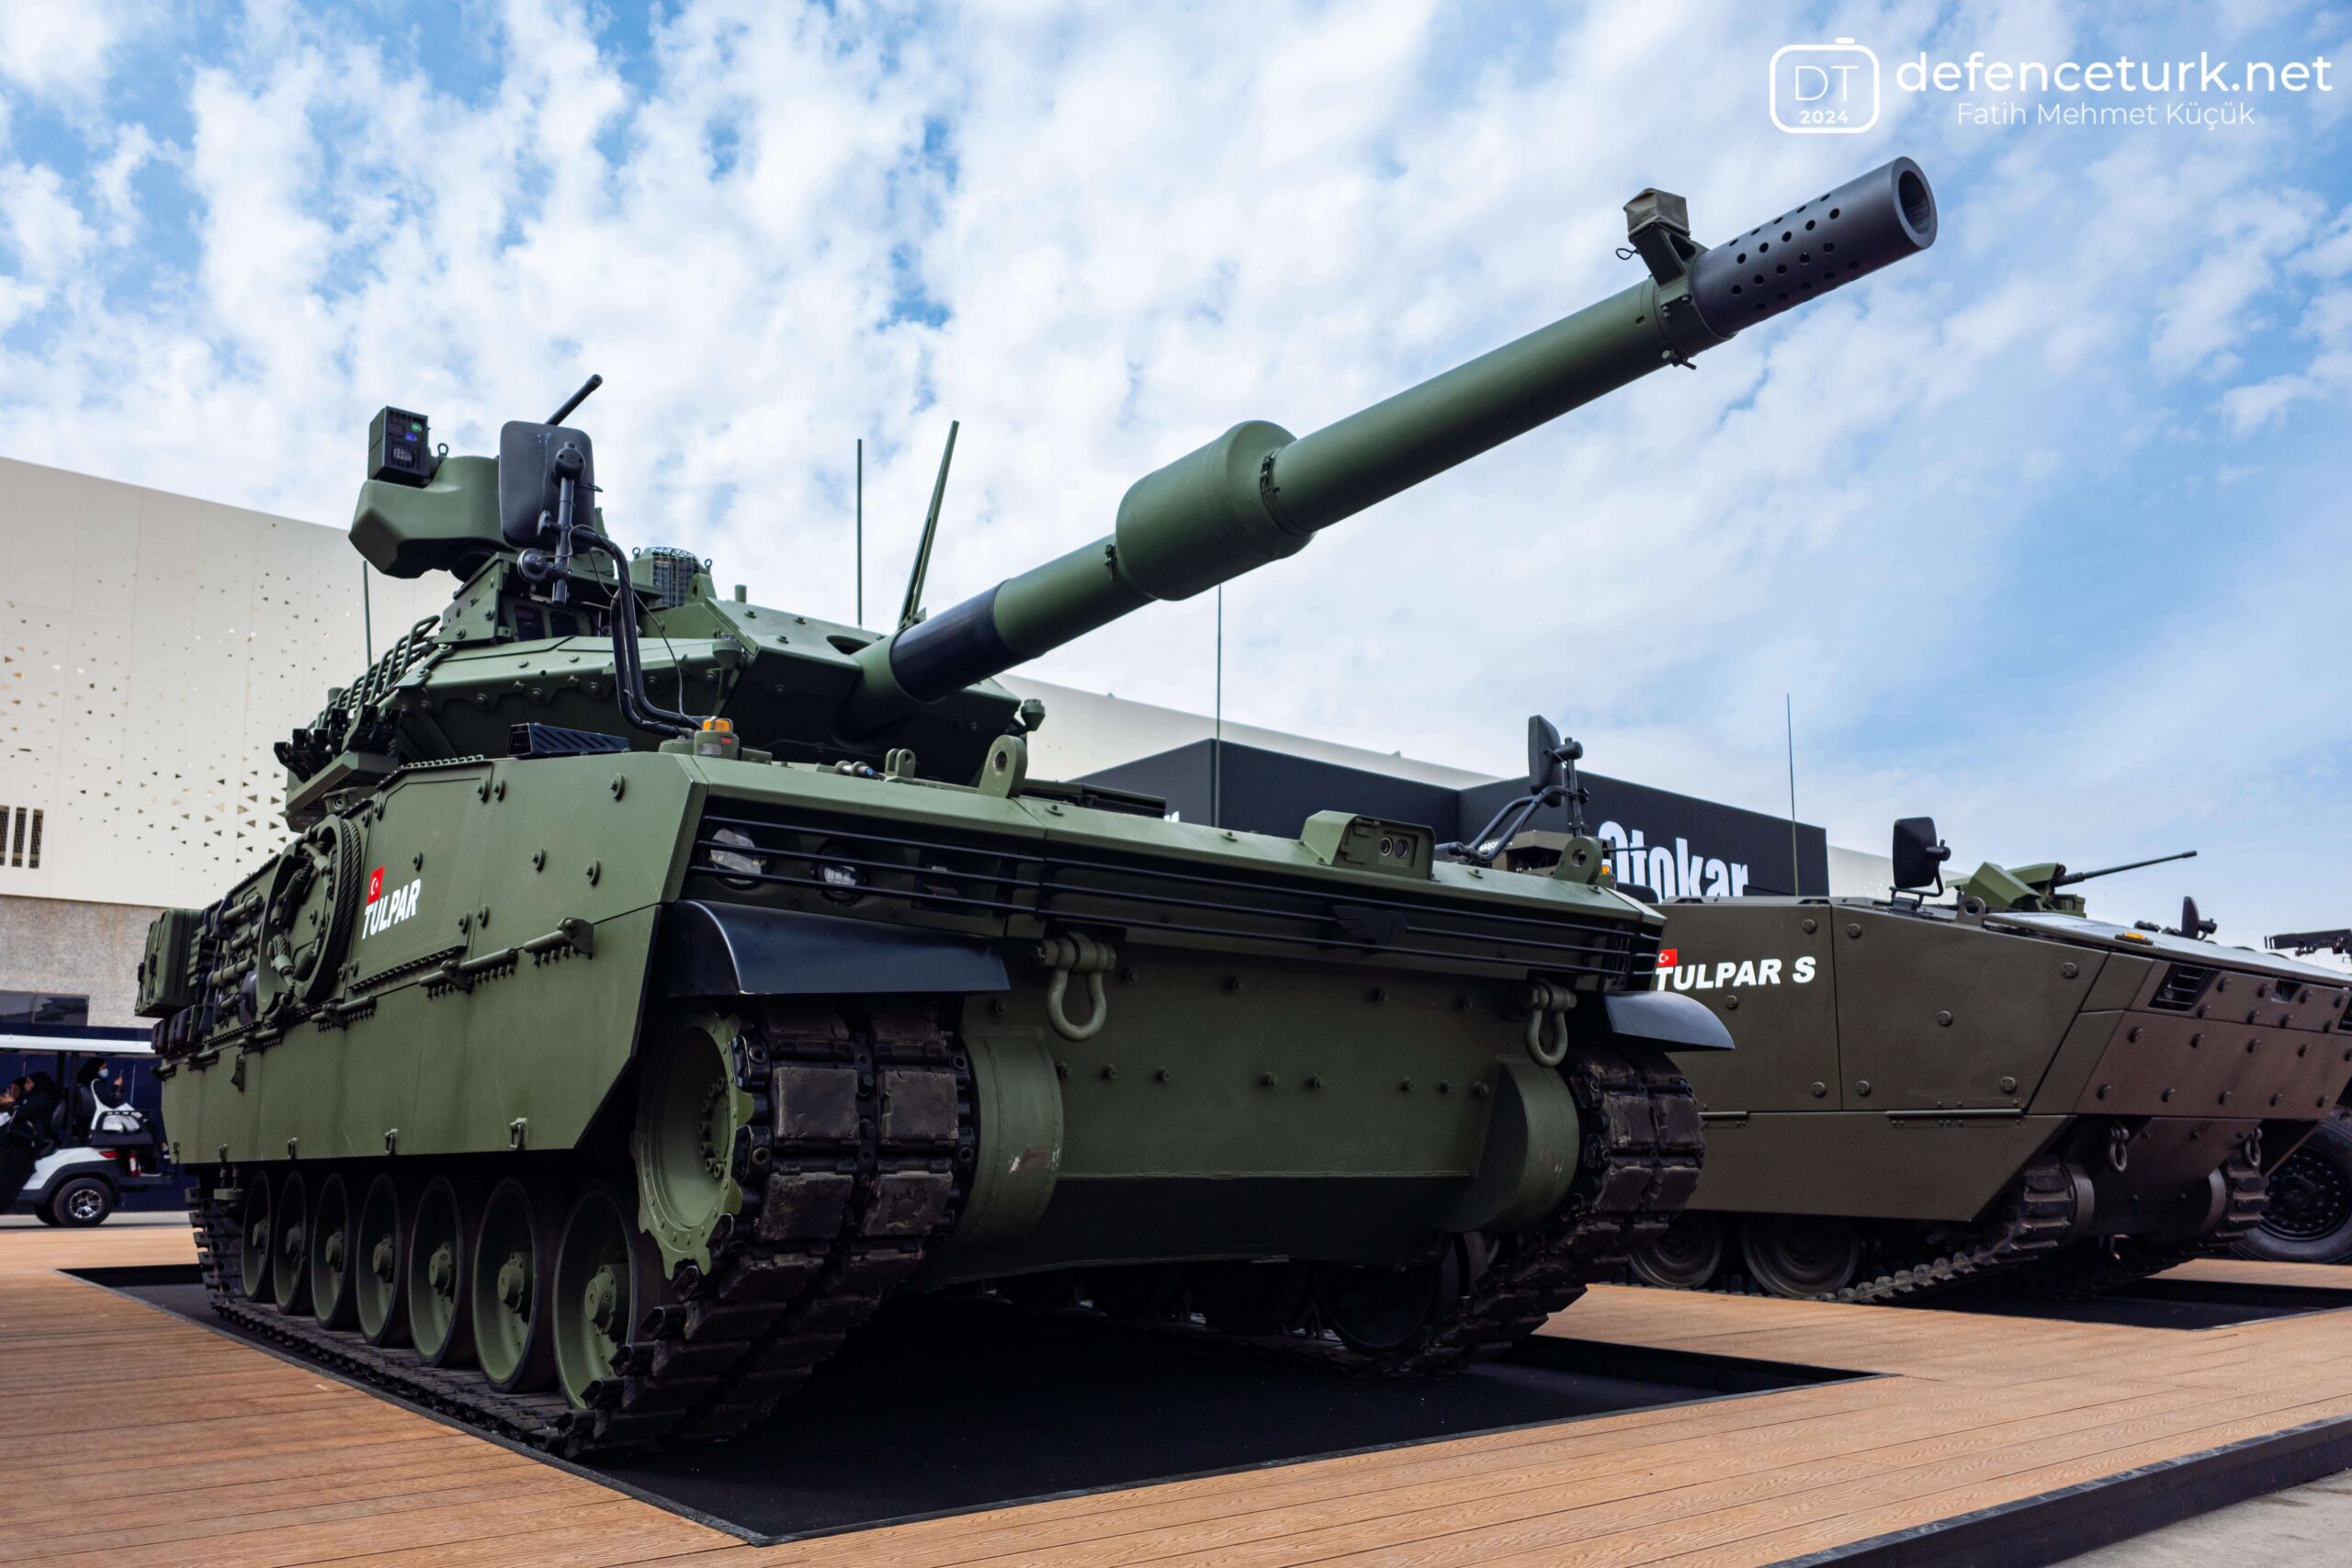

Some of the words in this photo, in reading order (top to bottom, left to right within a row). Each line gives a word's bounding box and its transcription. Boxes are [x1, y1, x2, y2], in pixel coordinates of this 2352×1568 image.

[362, 878, 422, 940] TULPAR
[1655, 958, 1782, 991] TULPAR
[1792, 956, 1816, 984] S
